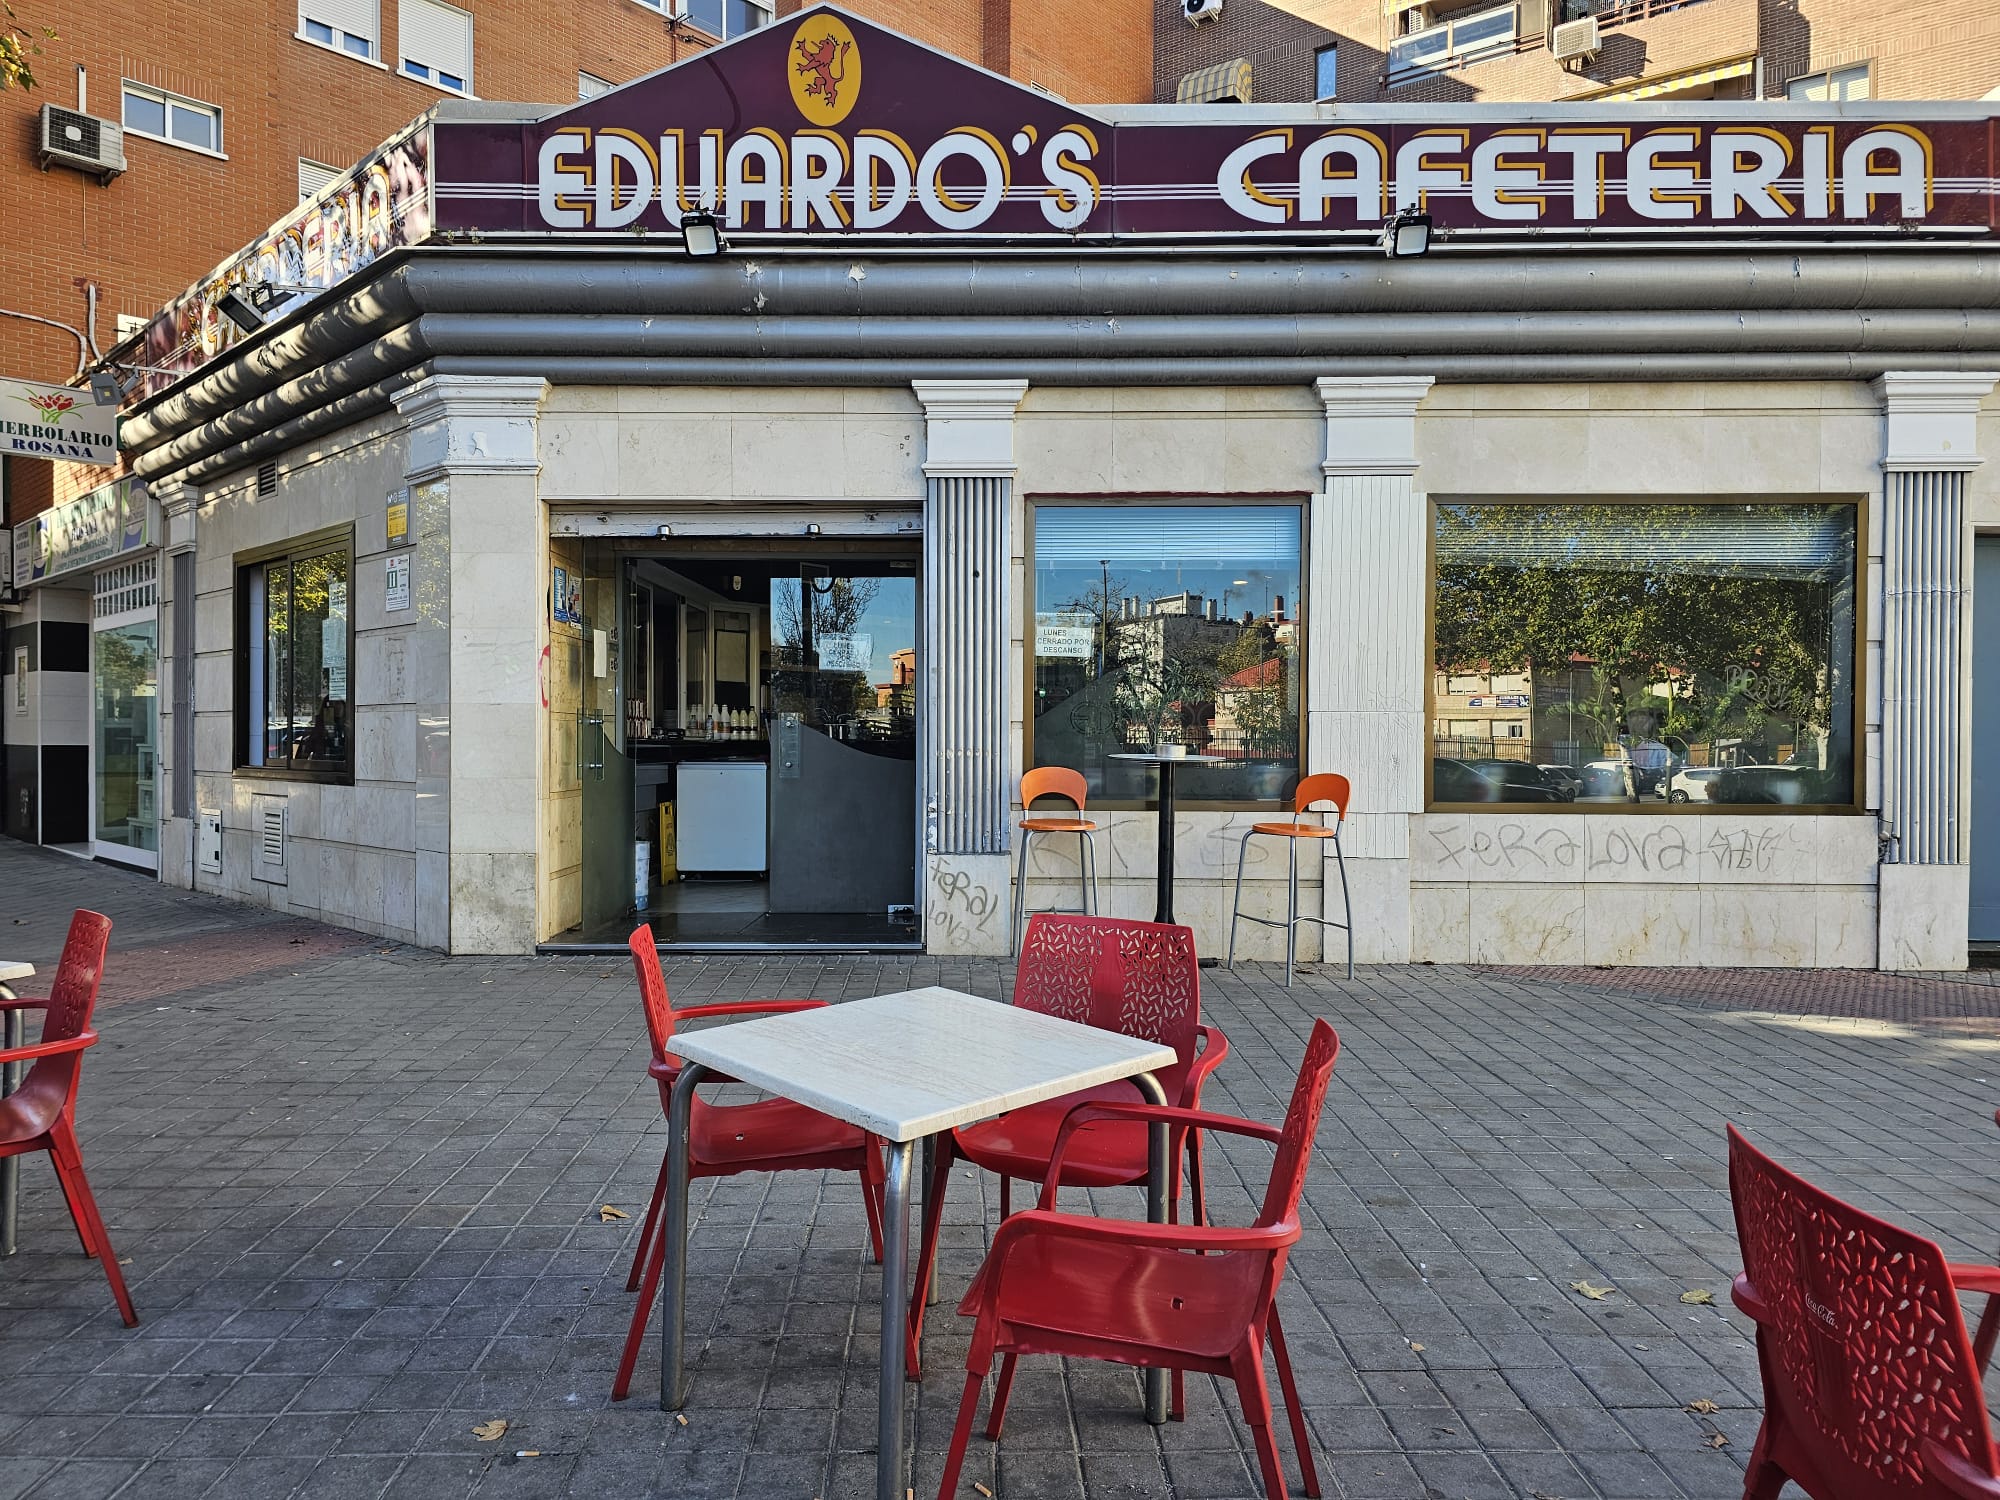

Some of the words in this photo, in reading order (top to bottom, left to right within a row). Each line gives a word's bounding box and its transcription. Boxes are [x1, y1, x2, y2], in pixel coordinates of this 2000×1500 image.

[538, 124, 1101, 230] EDUARDO'S
[1216, 124, 1935, 224] CAFETERIA
[12, 438, 94, 458] ROSANA
[1043, 628, 1067, 636] LUNES
[1037, 637, 1073, 645] CERRADO
[1074, 638, 1090, 646] POR
[1043, 646, 1083, 654] DESCANSO
